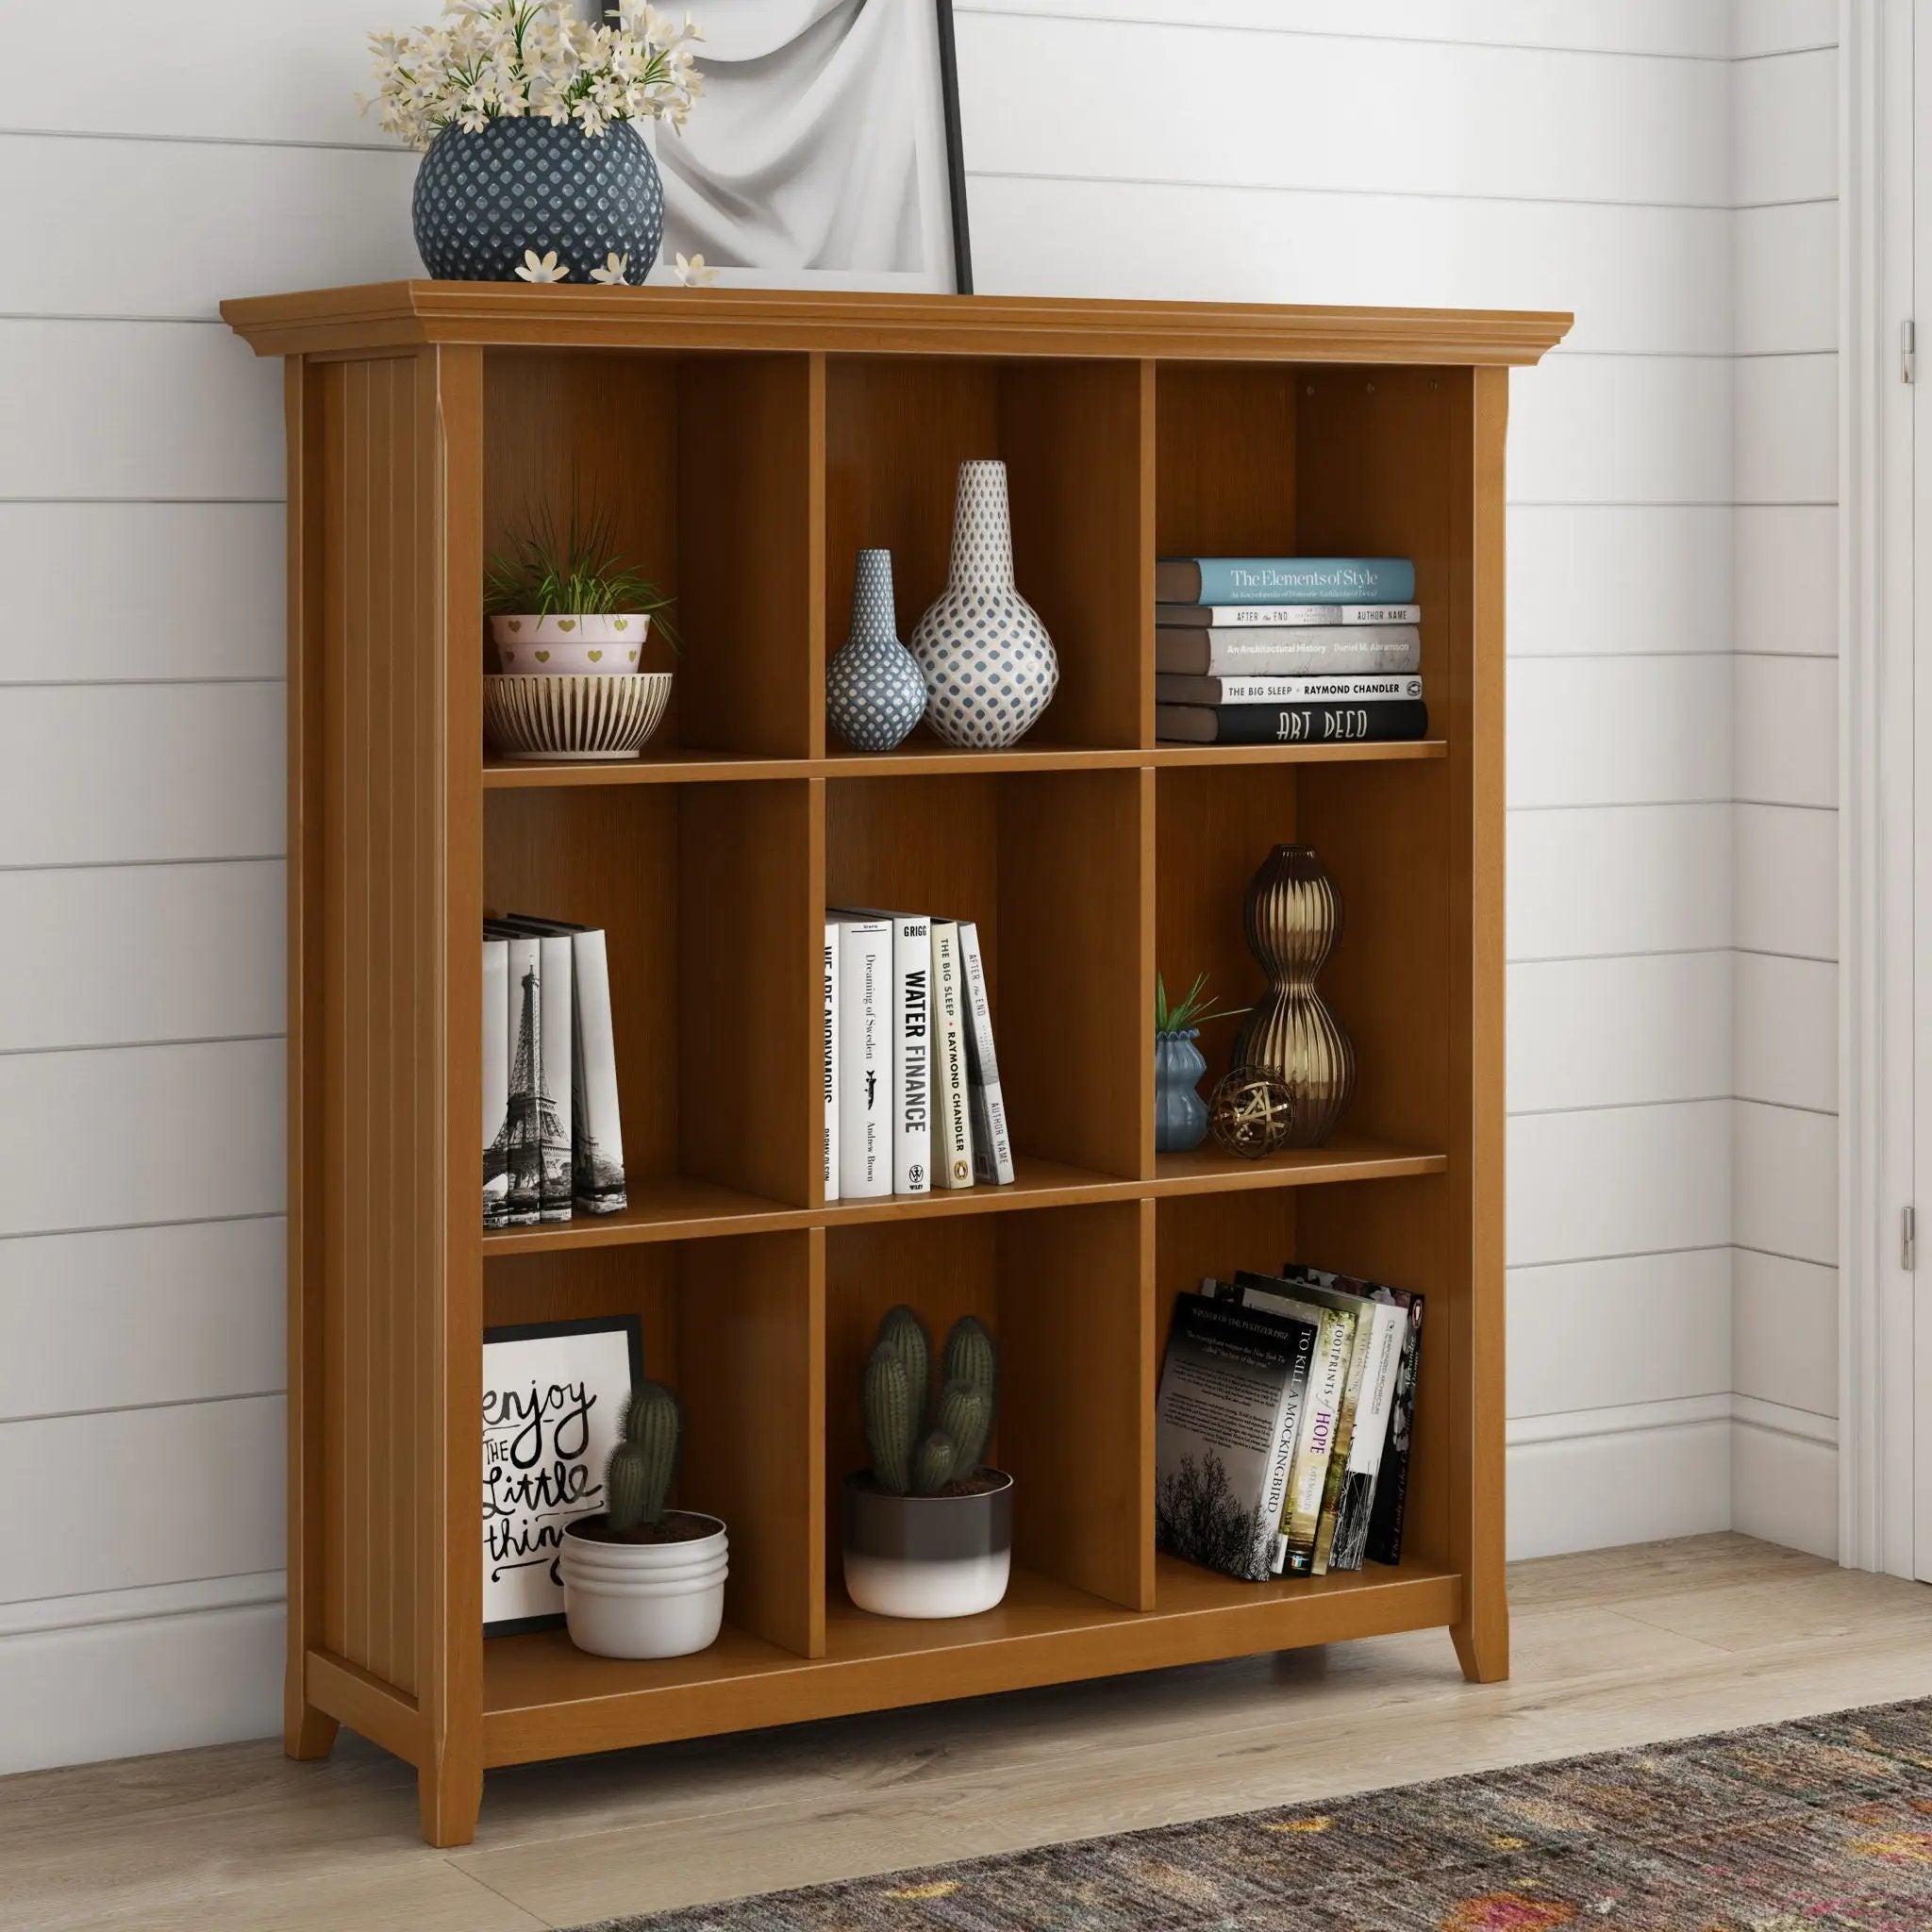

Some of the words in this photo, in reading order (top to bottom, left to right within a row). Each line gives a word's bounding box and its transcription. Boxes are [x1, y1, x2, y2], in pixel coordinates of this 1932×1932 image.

[1230, 570, 1260, 586] The
[1261, 570, 1327, 586] Elements
[1328, 570, 1341, 586] of
[1343, 569, 1378, 589] Style
[1238, 612, 1258, 621] AFTER
[1274, 611, 1288, 620] END
[1357, 611, 1383, 620] AUTHOR
[1388, 610, 1407, 620] NAME
[1227, 644, 1238, 653] An
[1296, 643, 1327, 654] History
[1334, 643, 1358, 652] Daniel
[1229, 687, 1244, 696] THE
[1248, 687, 1264, 695] BIG
[1268, 687, 1291, 695] SLEEP
[1304, 684, 1350, 694] RAYMOND
[1354, 684, 1399, 693] CHANDLER
[1276, 711, 1311, 740] ART
[1324, 709, 1367, 738] DECO
[904, 926, 926, 937] GRIGG
[941, 939, 949, 958] THE
[863, 955, 875, 1004] Dreaming
[942, 962, 951, 981] BIG
[969, 954, 980, 980] AFTER
[975, 998, 986, 1016] END
[865, 1007, 875, 1017] of
[905, 970, 925, 1038] WATER
[944, 987, 954, 1016] SLEEP
[865, 1020, 875, 1059] Sweden
[948, 1031, 959, 1089] RAYMOND
[905, 1045, 925, 1133] FINANCE
[952, 1093, 964, 1151] CHANDLER
[991, 1102, 1004, 1136] AUTHOR
[867, 1122, 875, 1152] Andrew
[997, 1140, 1008, 1163] NAME
[867, 1156, 875, 1182] Brown
[1298, 1330, 1312, 1351] TO
[1291, 1355, 1307, 1386] KILL
[1324, 1324, 1345, 1394] FOOTPRINTS
[1289, 1389, 1298, 1398] A
[483, 1380, 597, 1469] enjoy
[1310, 1412, 1331, 1454] HOPE
[483, 1439, 509, 1464] THE
[1268, 1403, 1297, 1513] MOCKINGBIRD
[483, 1460, 603, 1519] Little
